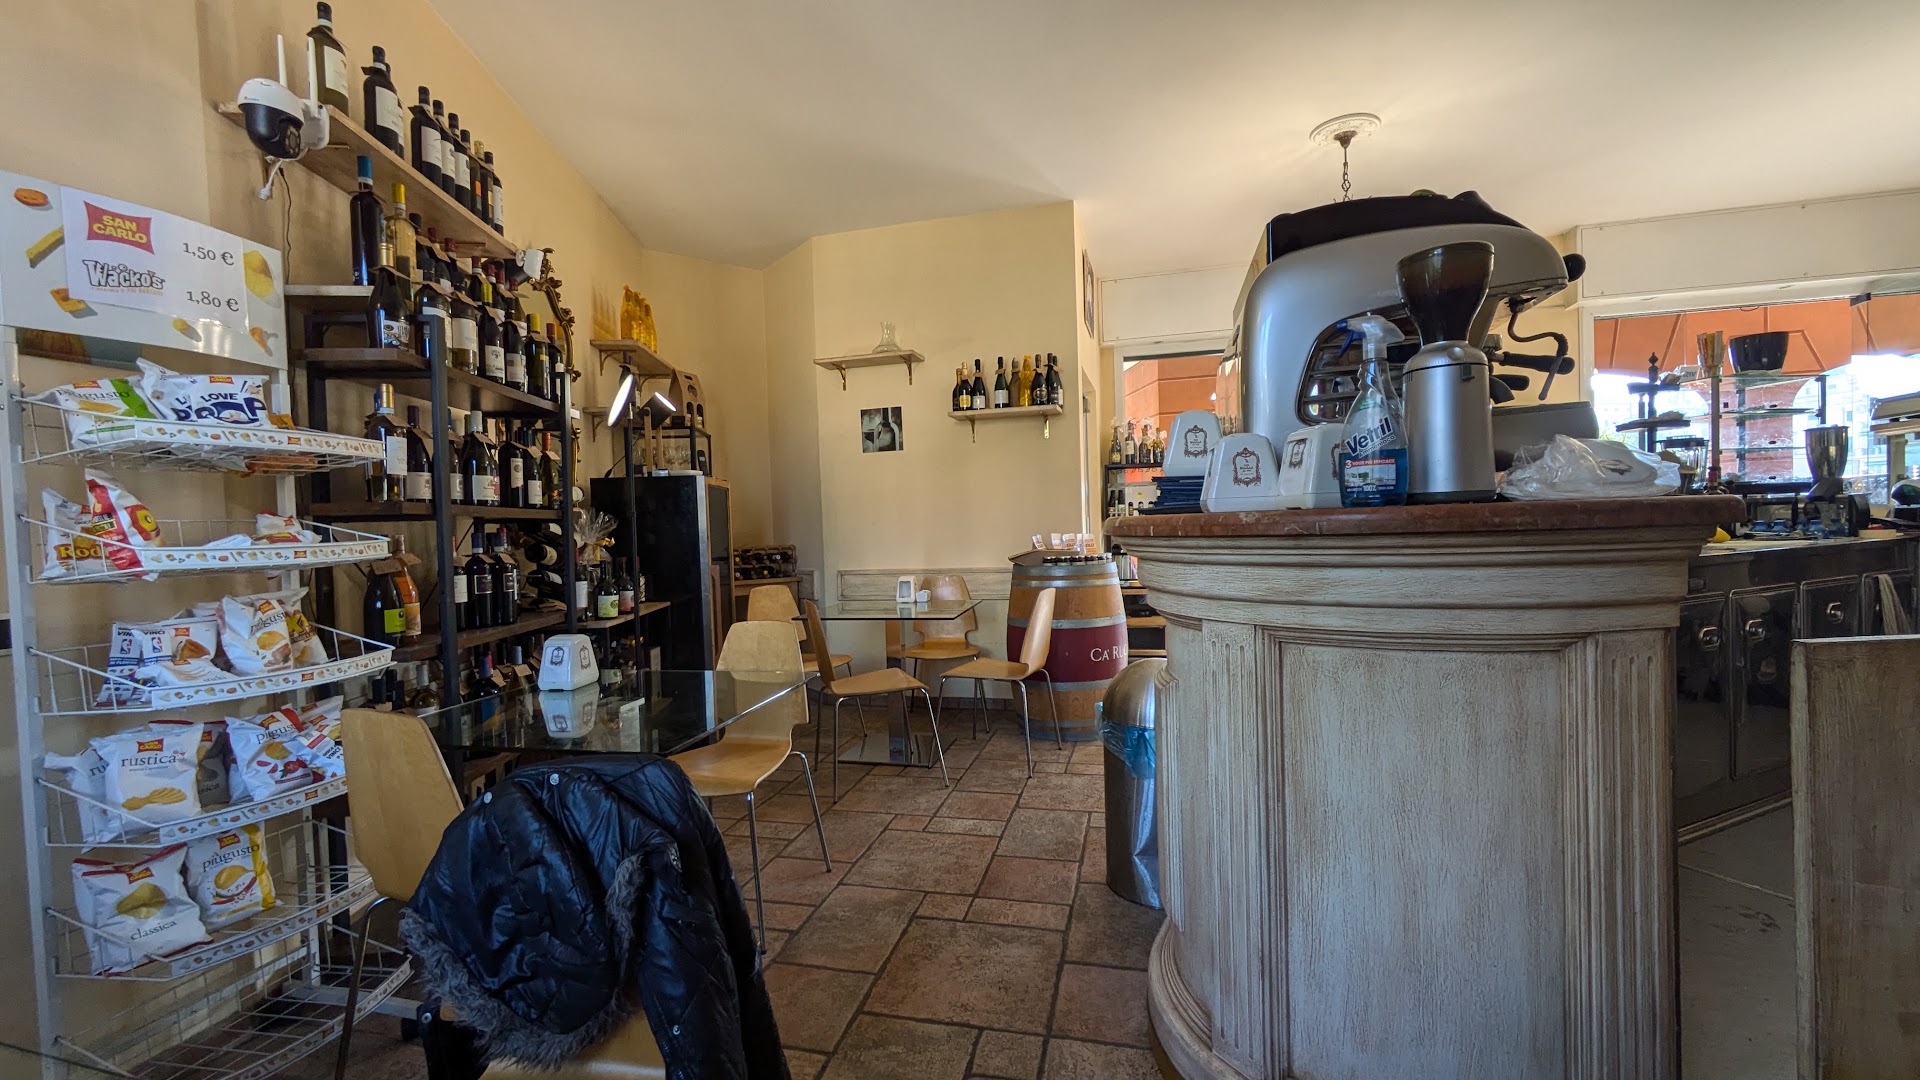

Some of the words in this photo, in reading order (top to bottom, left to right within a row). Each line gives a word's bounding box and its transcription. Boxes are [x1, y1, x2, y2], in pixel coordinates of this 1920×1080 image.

[103, 215, 137, 231] SAN
[93, 223, 148, 244] CARLO
[183, 242, 216, 260] 1,50
[221, 251, 234, 266] €
[187, 291, 221, 308] 1,80
[226, 298, 239, 312] €
[200, 392, 239, 403] LOVE
[1345, 415, 1393, 457] Vetril
[1345, 459, 1352, 468] 3
[60, 544, 105, 559] Rod
[121, 753, 176, 767] rustica
[326, 747, 341, 760] VINCI
[130, 919, 178, 941] classica
